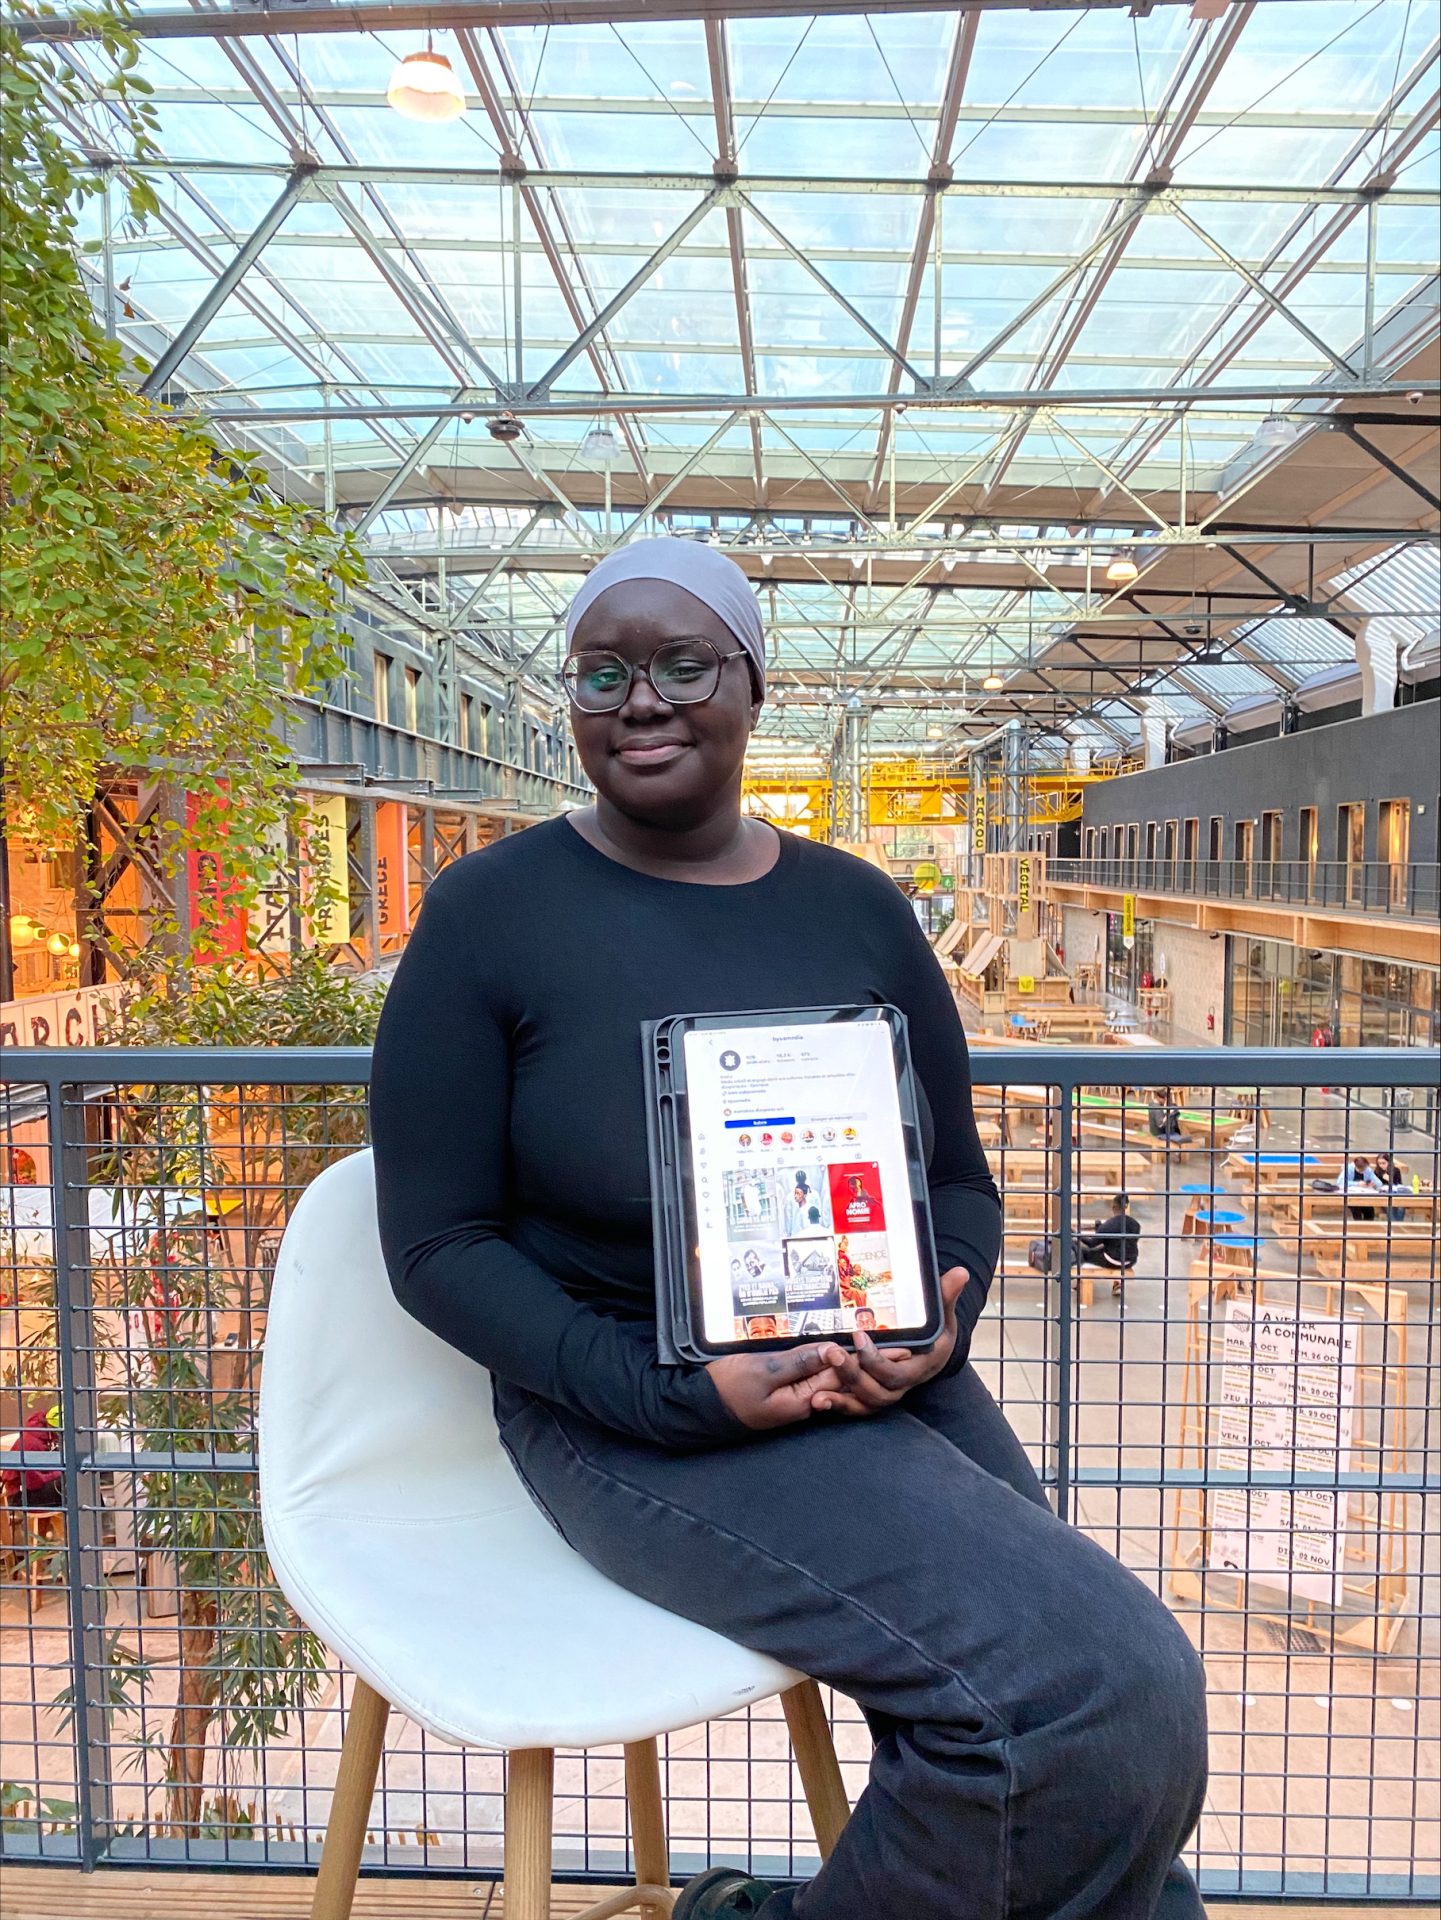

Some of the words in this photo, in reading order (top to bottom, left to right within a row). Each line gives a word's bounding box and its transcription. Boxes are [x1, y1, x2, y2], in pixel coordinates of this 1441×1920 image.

[976, 795, 985, 849] MAROC
[316, 814, 333, 932] FRAGES
[1019, 858, 1030, 913] VÉGÉTAL
[1275, 1314, 1316, 1331] VEIR
[1323, 1390, 1339, 1399] OC
